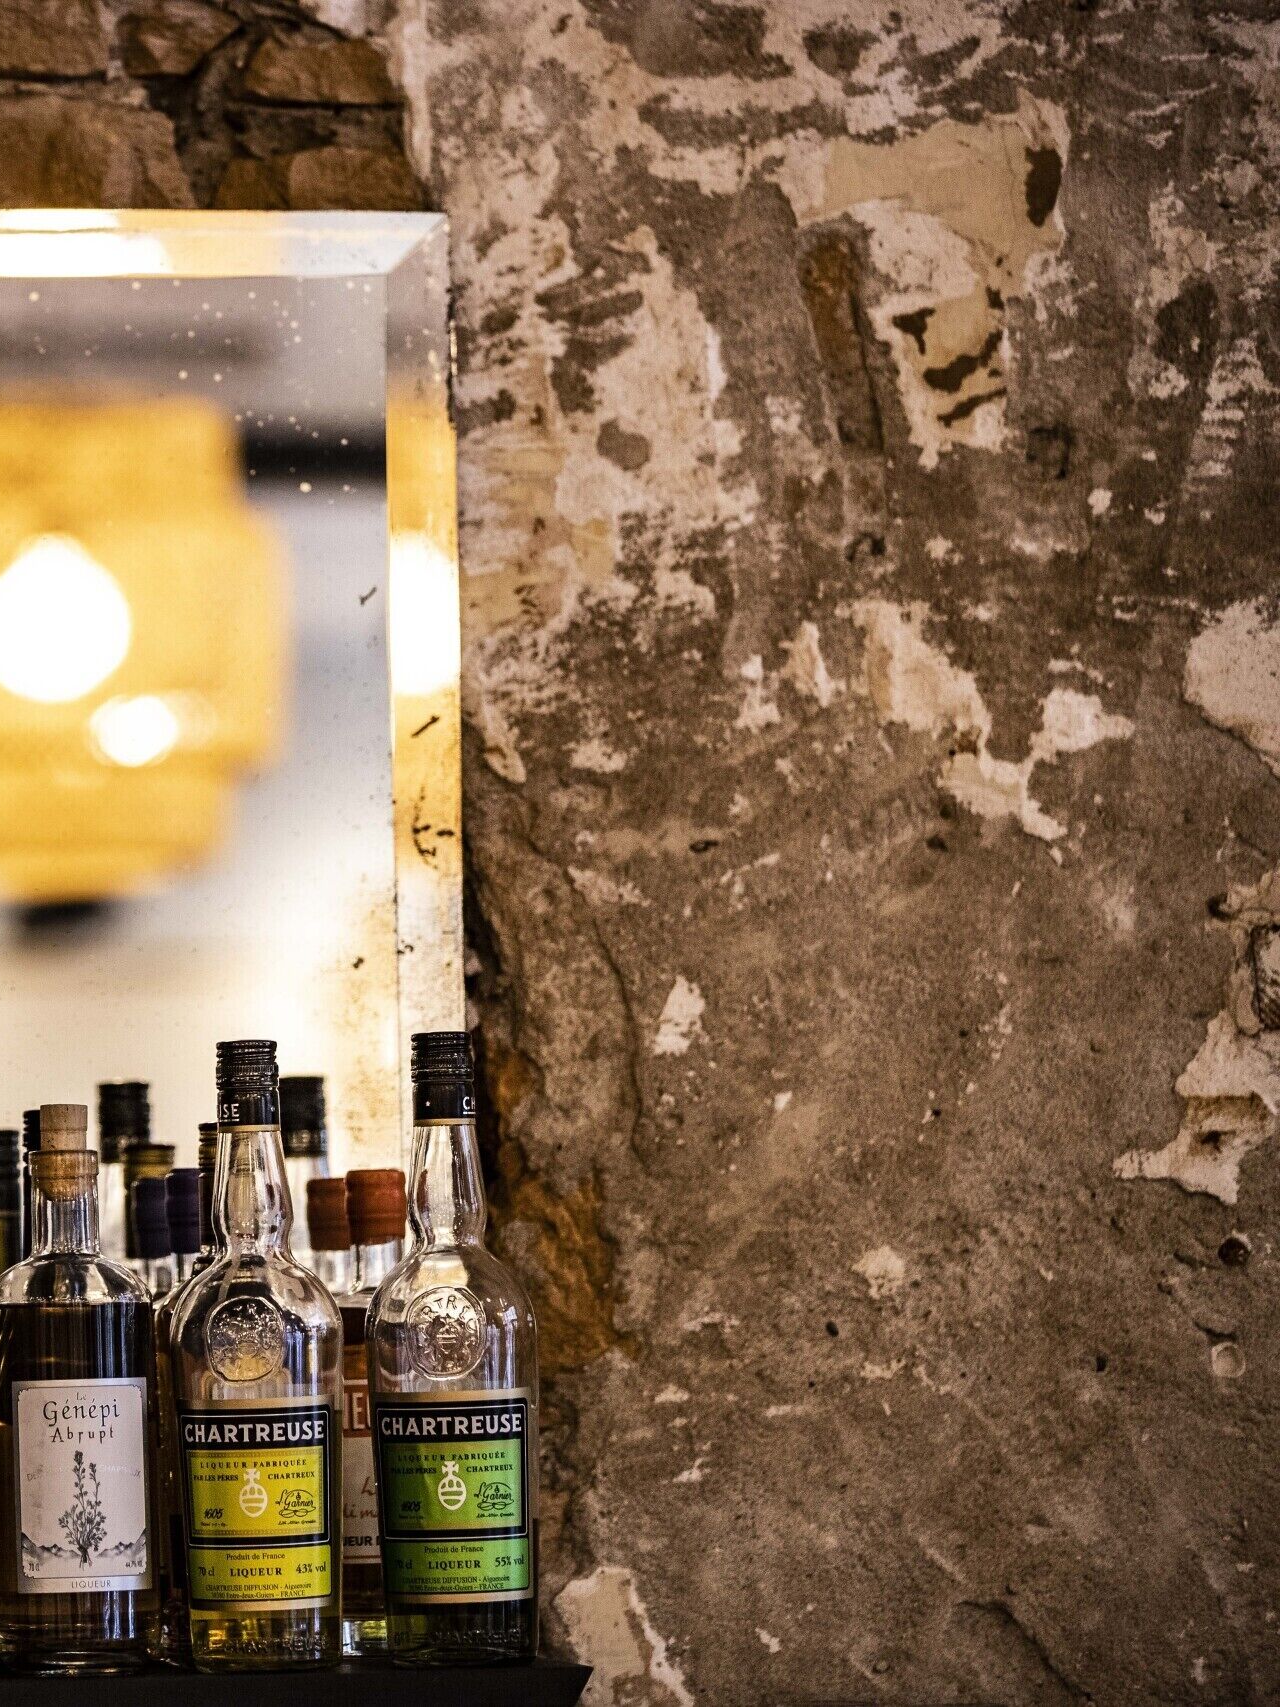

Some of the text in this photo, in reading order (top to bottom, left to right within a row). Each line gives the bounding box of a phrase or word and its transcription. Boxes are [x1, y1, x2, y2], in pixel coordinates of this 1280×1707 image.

[42, 1398, 120, 1427] Génépi
[381, 1413, 522, 1436] CHARTREUSE
[50, 1426, 115, 1444] Abrupt
[184, 1420, 325, 1443] CHARTREUSE
[398, 1450, 506, 1462] LIQUEUR FABRIQUÉE
[200, 1459, 307, 1469] LIQUEUR FABRIQUÉE
[466, 1464, 514, 1473] CHARTREUX
[268, 1472, 316, 1480] CHARTREUX
[424, 1544, 484, 1554] Produit de France
[226, 1552, 286, 1560] Produit de France
[428, 1555, 525, 1570] LIQUEUR 55% vol
[230, 1568, 282, 1578] LIQUEUR
[296, 1563, 313, 1574] 43%
[315, 1562, 326, 1572] vol
[70, 1579, 112, 1589] LIQUEUR
[441, 1576, 478, 1584] DIFFUSION
[478, 1582, 504, 1590] FRANCE
